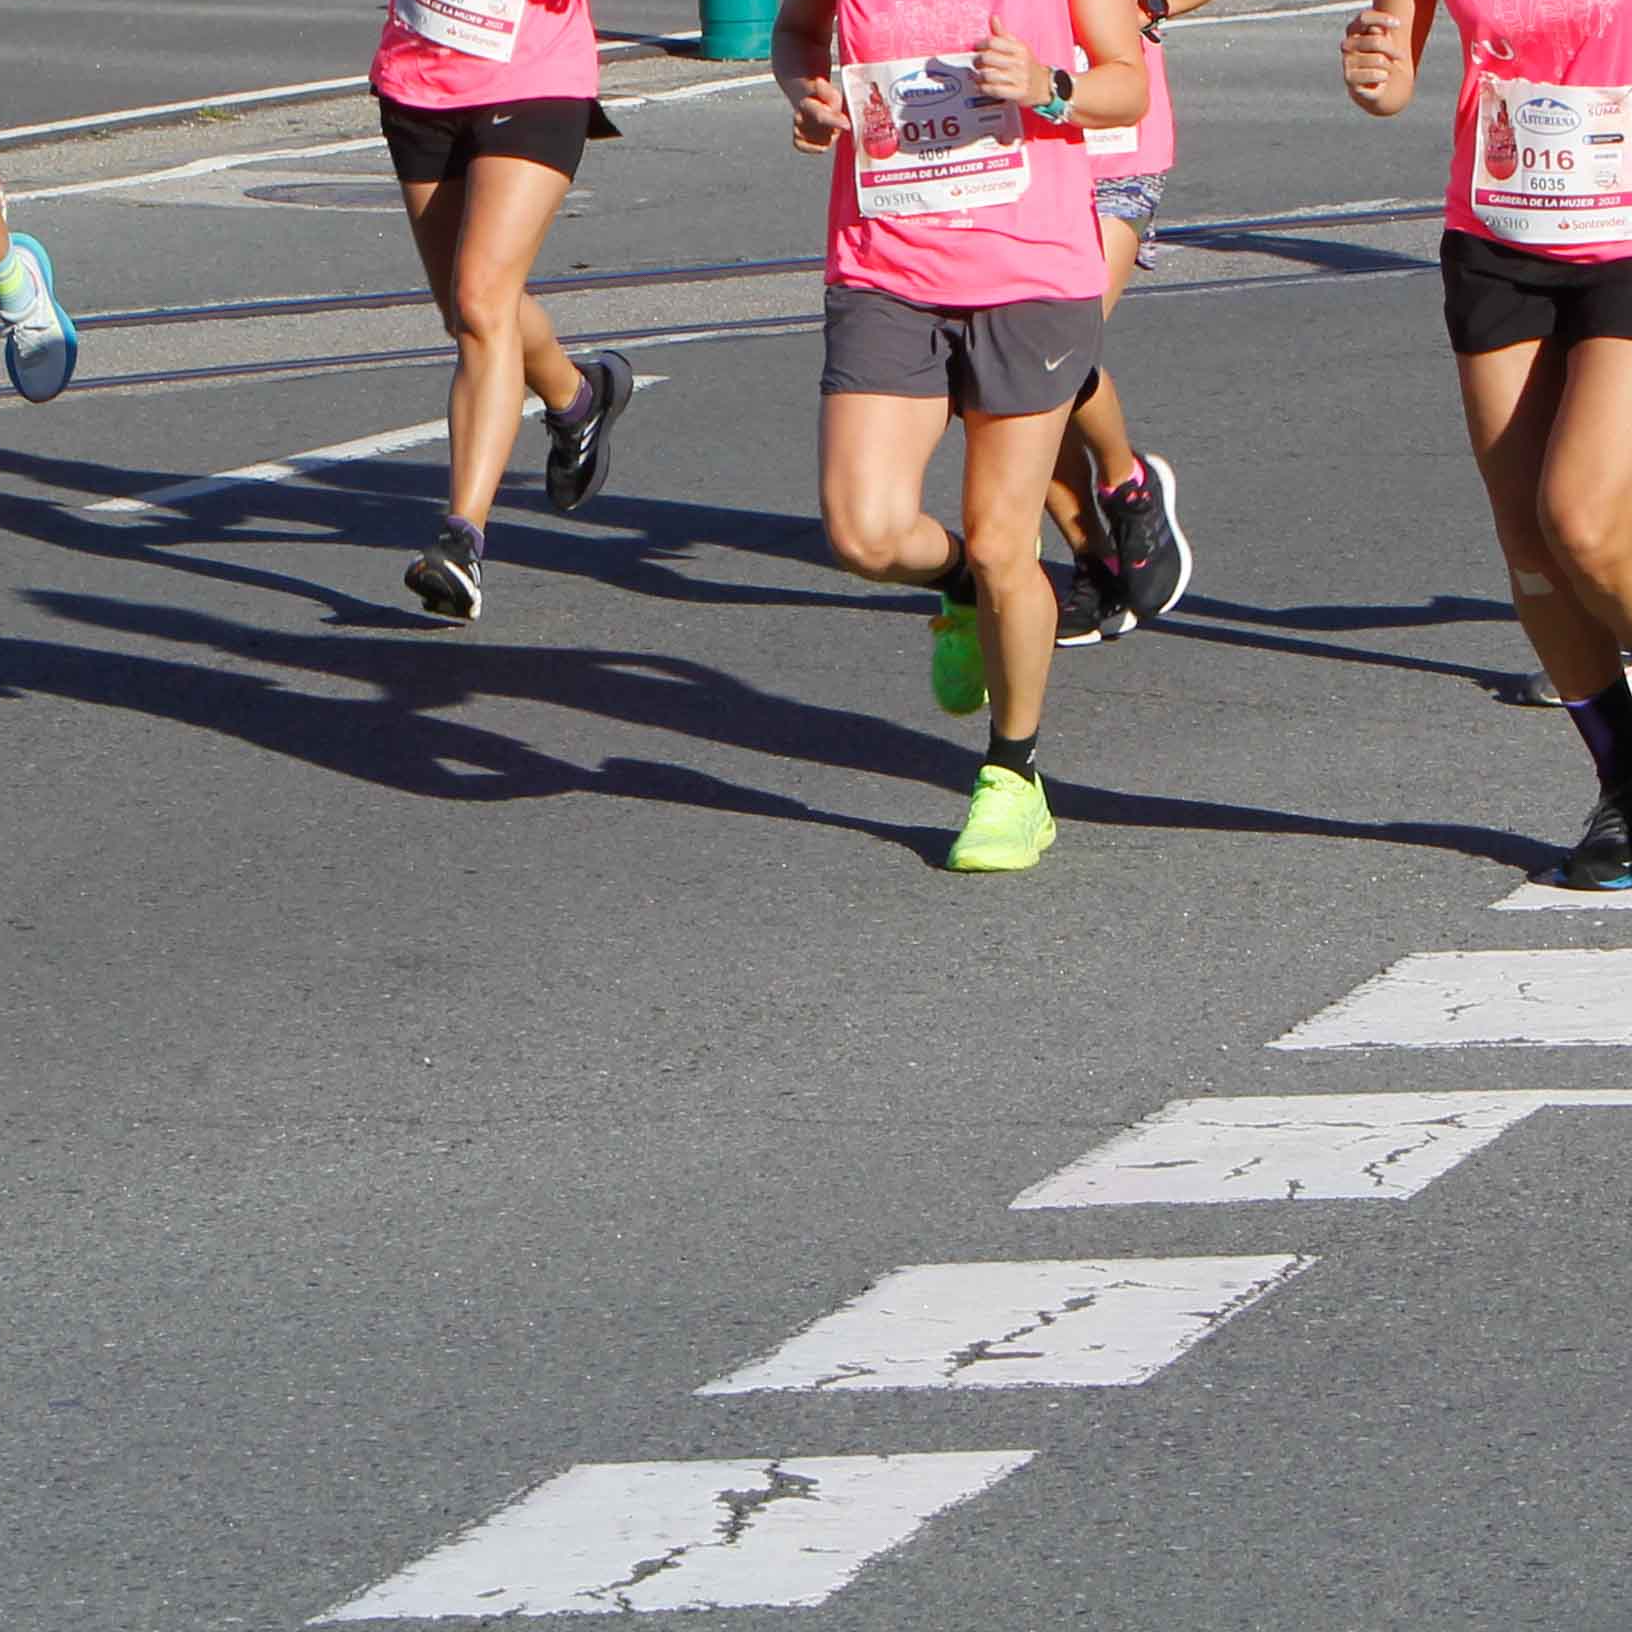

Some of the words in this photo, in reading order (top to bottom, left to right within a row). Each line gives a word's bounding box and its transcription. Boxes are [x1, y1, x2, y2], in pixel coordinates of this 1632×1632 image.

[903, 116, 960, 142] 016
[1522, 147, 1575, 171] 016
[873, 172, 918, 184] CARRERA
[919, 170, 933, 179] DE
[934, 167, 949, 177] LA
[949, 162, 984, 174] MUJER
[1530, 176, 1566, 192] 6035
[1488, 194, 1528, 205] CARRERA
[1529, 198, 1543, 207] DE
[1544, 199, 1558, 207] LA
[1559, 198, 1595, 208] MUJER
[1572, 218, 1625, 231] Santander
